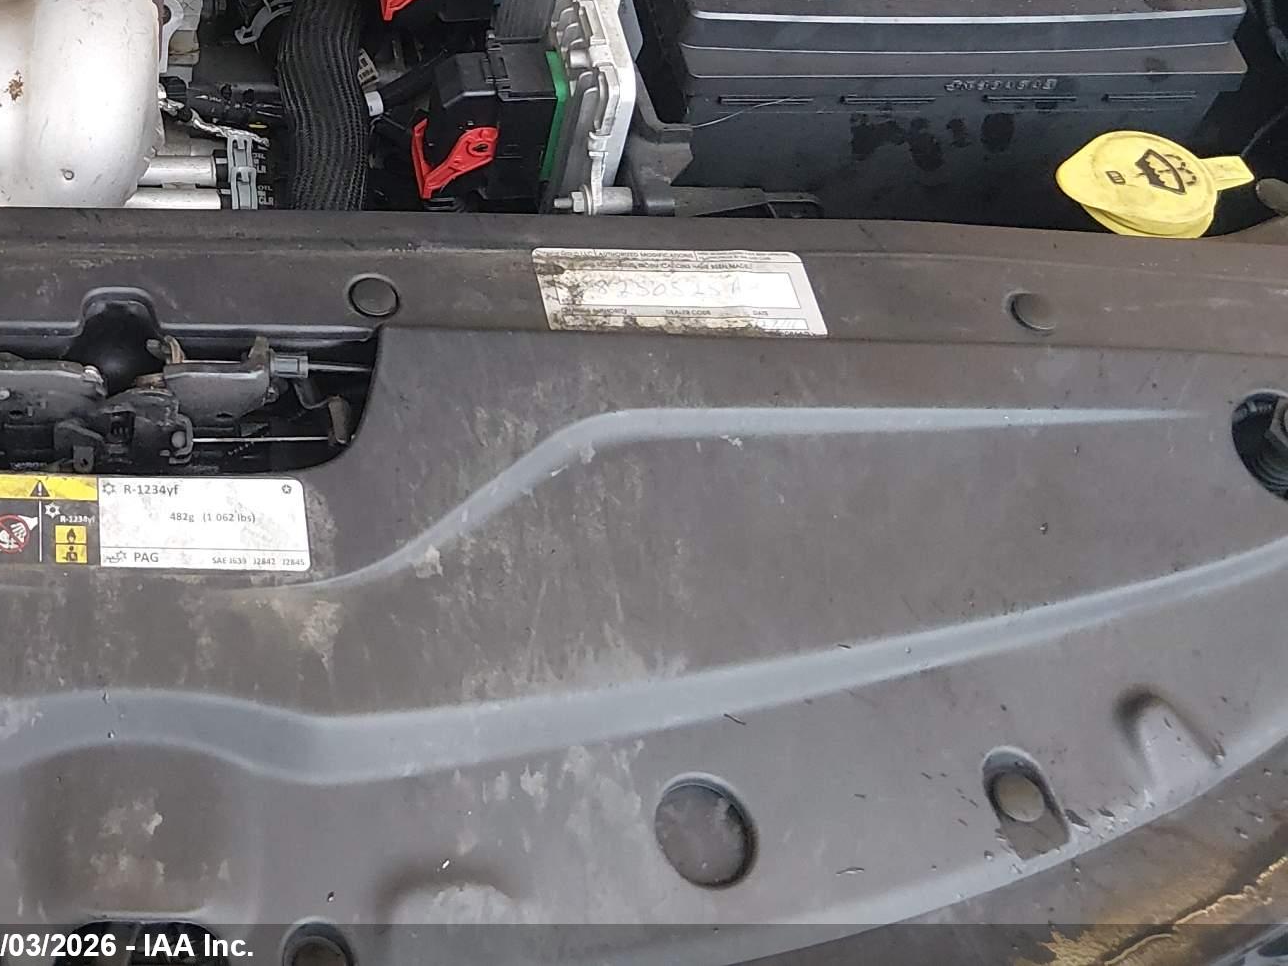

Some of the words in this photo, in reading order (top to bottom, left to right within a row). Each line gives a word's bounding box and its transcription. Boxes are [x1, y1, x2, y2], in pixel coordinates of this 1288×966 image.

[123, 484, 180, 496] R-1234yf
[169, 512, 194, 523] 482g
[237, 512, 256, 523] lbs)
[134, 552, 159, 563] PAG
